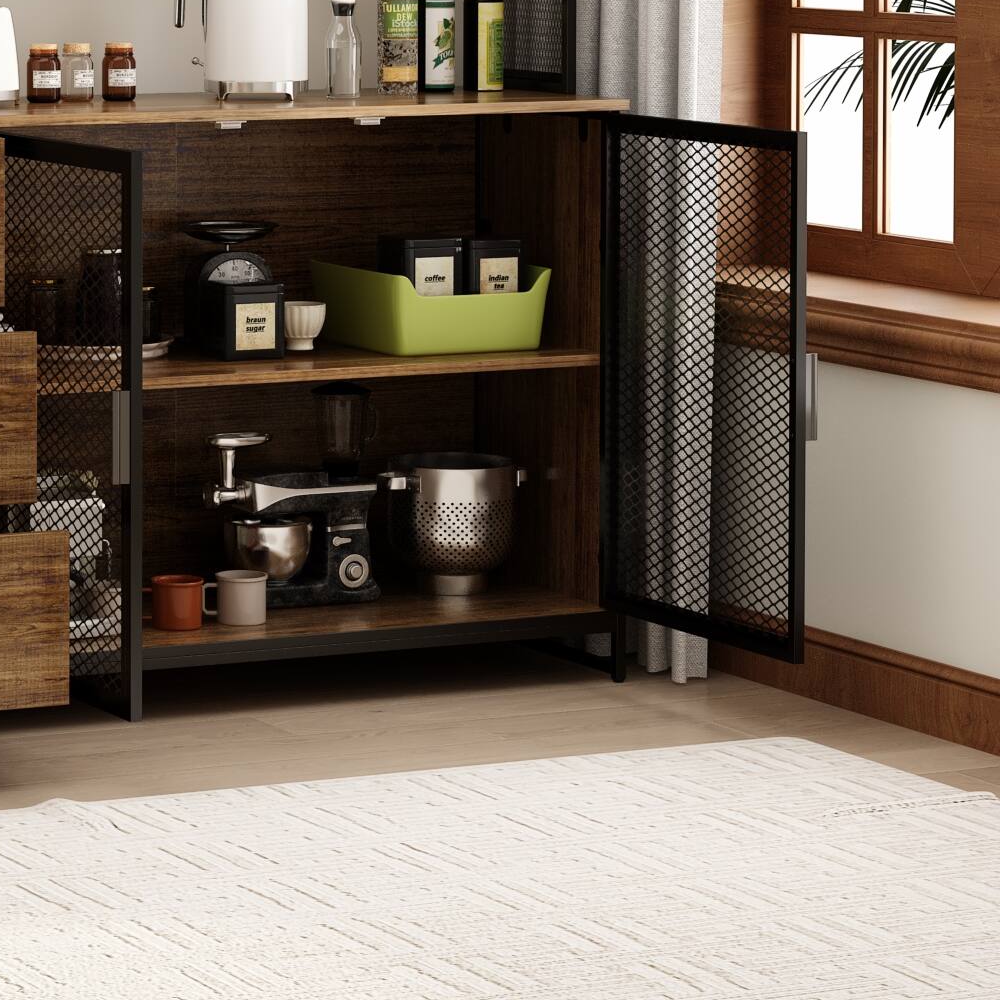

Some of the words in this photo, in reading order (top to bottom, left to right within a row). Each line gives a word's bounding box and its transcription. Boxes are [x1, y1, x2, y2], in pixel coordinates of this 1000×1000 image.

[397, 13, 413, 21] DEW
[424, 274, 446, 282] coffee
[488, 274, 509, 282] indian
